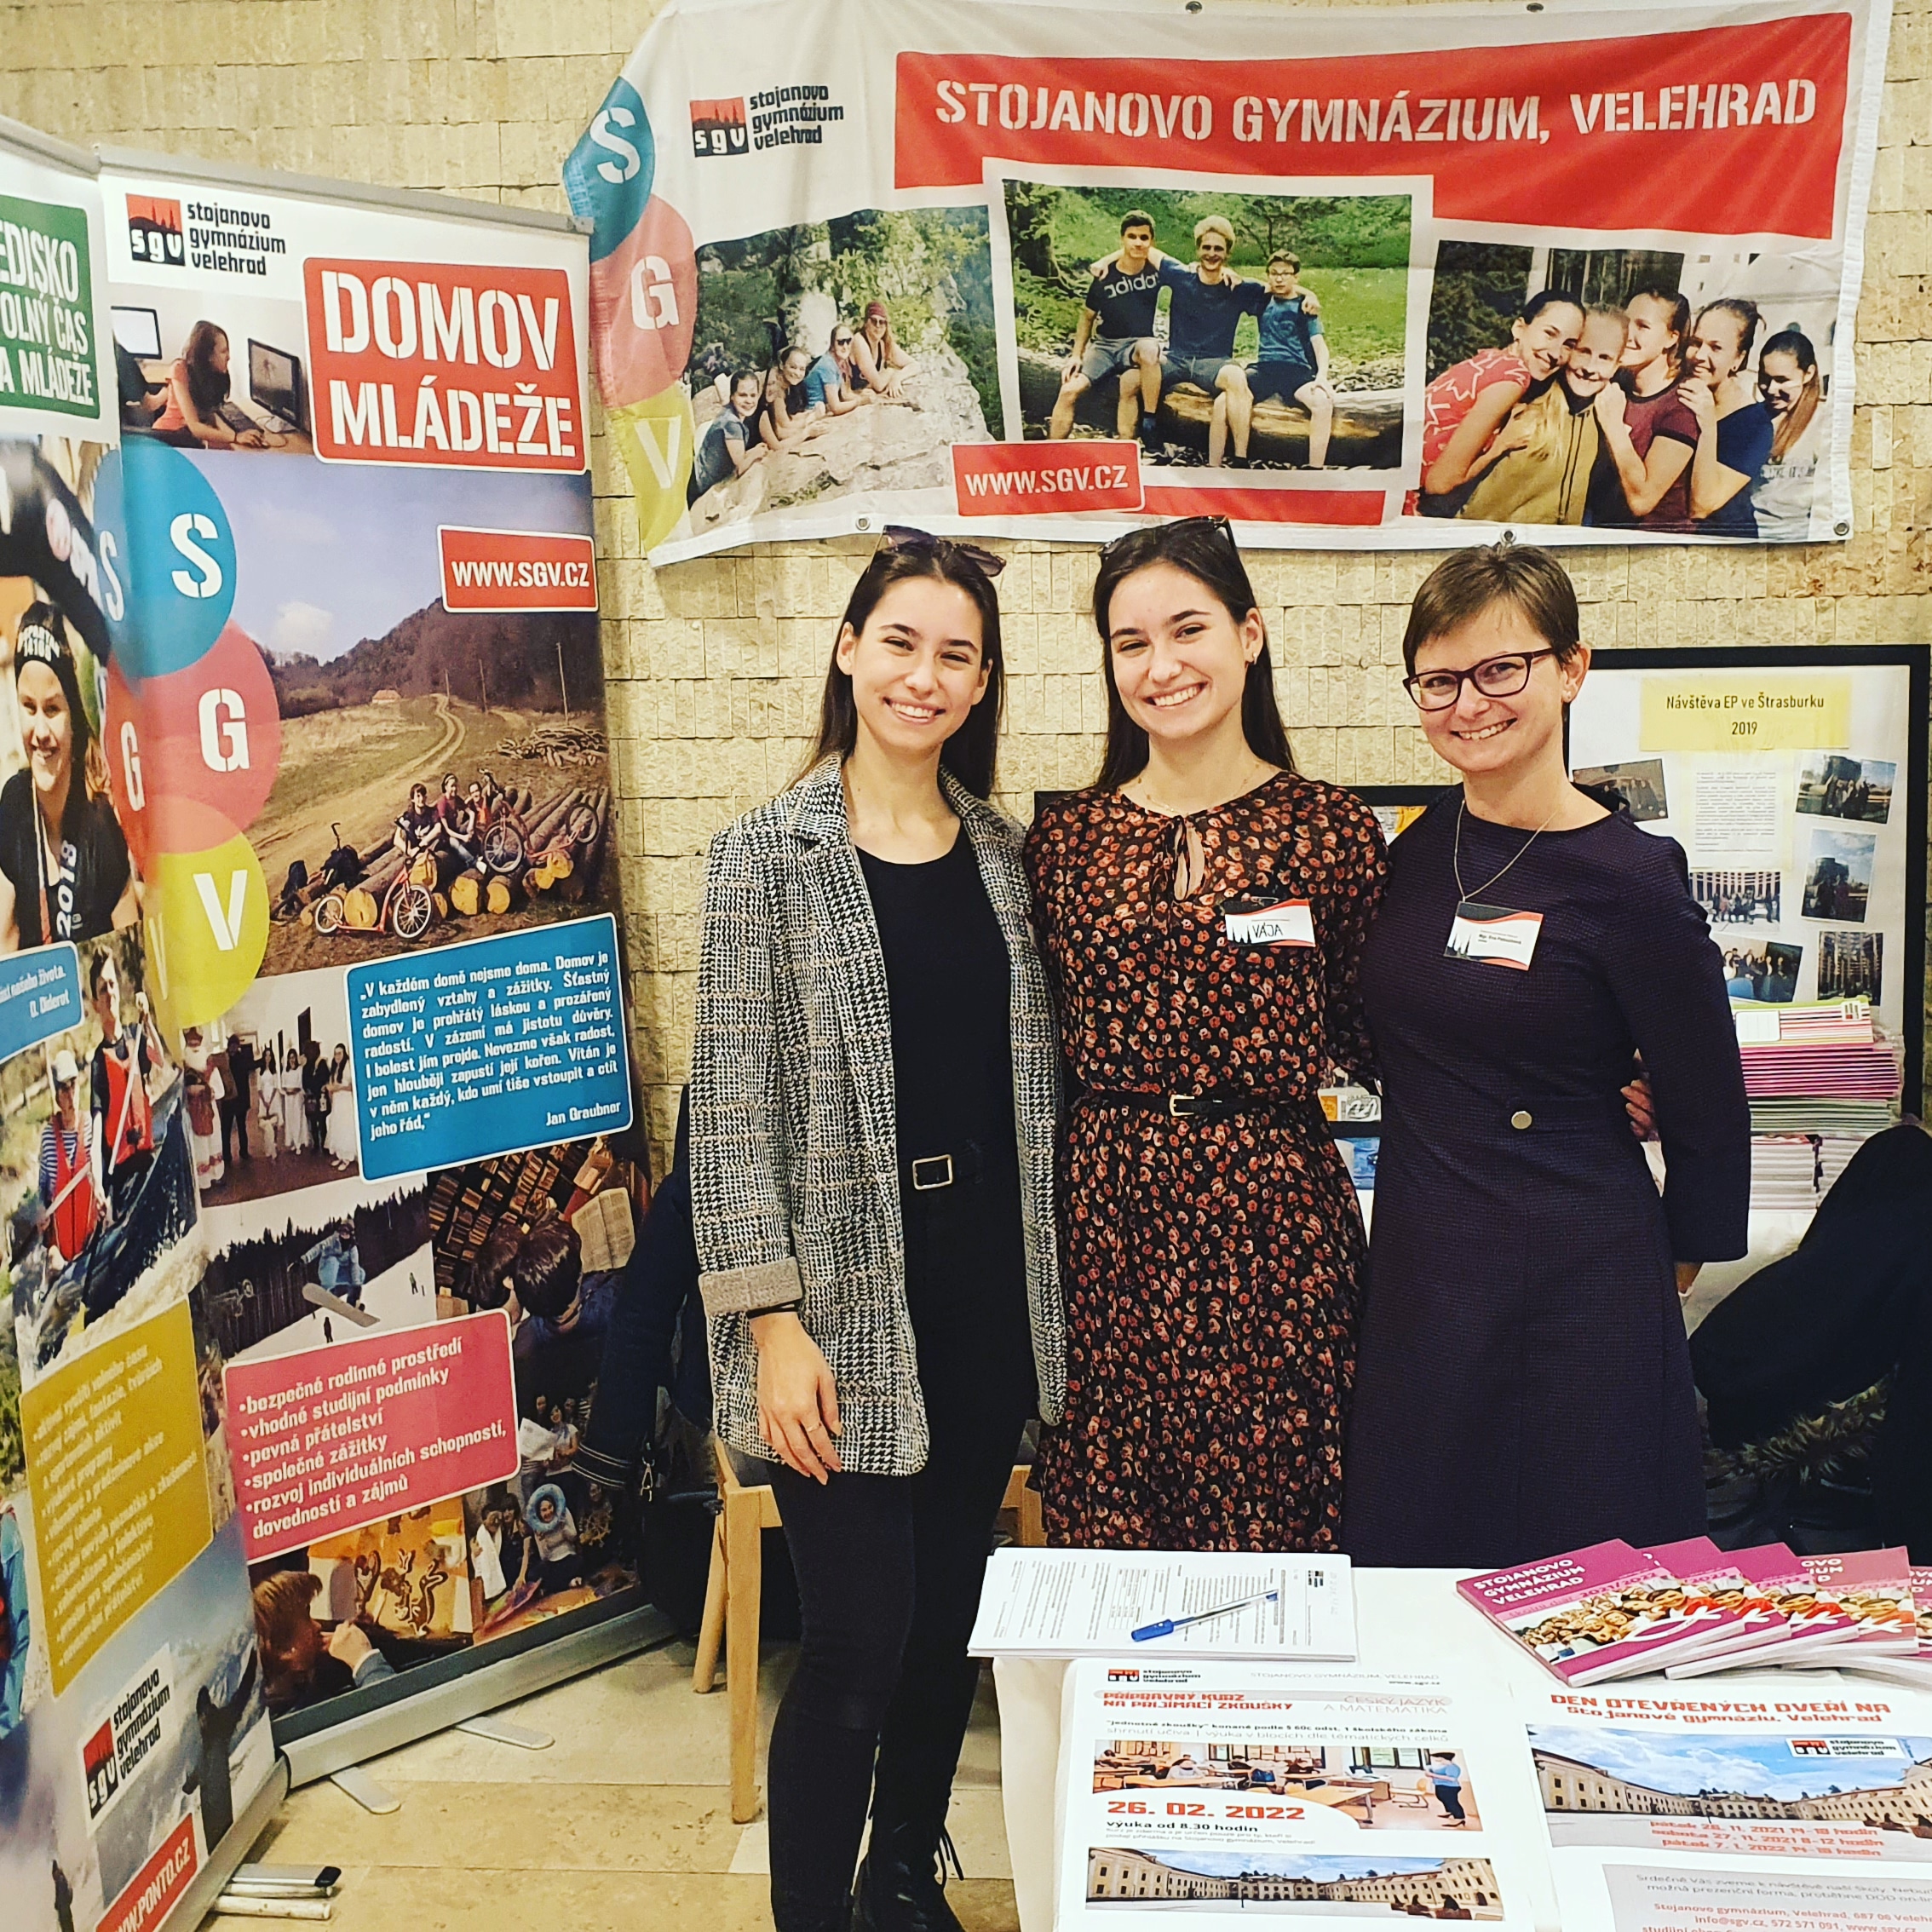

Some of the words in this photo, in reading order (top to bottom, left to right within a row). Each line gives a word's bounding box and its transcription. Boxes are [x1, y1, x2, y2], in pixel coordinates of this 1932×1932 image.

[750, 84, 830, 112] stojanovo
[752, 101, 844, 134] gymnázium
[936, 79, 1213, 141] STOJANOVO
[1232, 89, 1550, 145] GYMNÁZIUM,
[1569, 78, 1817, 135] VELEHRAD
[589, 106, 641, 184] S
[694, 127, 746, 155] sgv
[753, 124, 823, 151] velehrad
[187, 202, 270, 229] stojanovo
[132, 229, 183, 263] sgv
[189, 227, 286, 255] gymnázium
[192, 250, 267, 275] velehrad
[630, 255, 681, 331] G
[1104, 272, 1160, 299] adida
[54, 296, 89, 356] ČAS
[321, 270, 561, 371] DOMOV
[19, 347, 95, 406] MLÁDEŽE
[330, 374, 576, 457] MLÁDEŽE
[633, 421, 680, 489] V
[963, 463, 1130, 498] WWW.SGV.CZ
[170, 513, 223, 599] S
[451, 559, 590, 589] WWW.SGV.CZ
[1666, 694, 1721, 710] Návštěva
[1723, 695, 1738, 709] EP
[1740, 699, 1755, 709] ve
[1757, 692, 1825, 709] Štrasburku
[198, 687, 250, 773] G
[1732, 722, 1758, 736] 2019
[193, 870, 248, 952] V
[361, 998, 425, 1019] zabydlený
[436, 989, 477, 1007] vztahy
[487, 987, 495, 998] a
[506, 979, 552, 996] zážitky.
[562, 971, 609, 987] Šťastný
[378, 976, 429, 996] každém
[433, 969, 466, 987] domě
[469, 966, 511, 983] nejsme
[515, 960, 551, 975] doma.
[555, 954, 595, 970] Domov
[597, 951, 608, 967] je
[362, 1021, 404, 1038] domov
[411, 1016, 424, 1033] je
[432, 1007, 483, 1031] prohřátý
[490, 1001, 530, 1017] láskou
[538, 999, 546, 1010] a
[553, 989, 611, 1010] prozářený
[364, 1037, 414, 1059] radostí.
[424, 1032, 434, 1048] V
[445, 1024, 485, 1045] zázemí
[494, 1020, 513, 1036] má
[521, 1014, 562, 1035] jistotu
[572, 1006, 612, 1023] důvěry.
[365, 1063, 371, 1078] I
[374, 1057, 415, 1077] bolest
[417, 1054, 438, 1072] jím
[441, 1045, 480, 1068] projde.
[484, 1038, 537, 1057] Nevezme
[540, 1029, 571, 1047] však
[574, 1024, 615, 1042] radost,
[366, 1084, 387, 1101] jen
[394, 1071, 444, 1093] hlouběji
[451, 1061, 493, 1084] zapustí
[499, 1057, 518, 1077] její
[524, 1053, 561, 1069] kořen.
[567, 1044, 600, 1061] Vítán
[605, 1042, 616, 1058] je
[369, 1107, 377, 1118] v
[381, 1099, 409, 1116] něm
[411, 1090, 454, 1110] každý,
[457, 1084, 478, 1101] kdo
[480, 1078, 503, 1096] umí
[505, 1076, 529, 1091] tiše
[532, 1066, 583, 1086] vstoupit
[586, 1066, 594, 1077] a
[597, 1060, 618, 1075] ctít
[545, 1112, 566, 1125] Jan
[568, 1101, 620, 1121] Graubner
[370, 1120, 397, 1141] jeho
[246, 1377, 323, 1415] bezpečné
[327, 1360, 386, 1390] rodinné
[391, 1337, 462, 1375] prostředí
[248, 1406, 308, 1439] vhodné
[312, 1386, 371, 1420] studijní
[375, 1367, 449, 1405] podmínky
[250, 1433, 300, 1467] pevná
[304, 1408, 382, 1451] přátelství
[251, 1451, 325, 1488] společné
[329, 1434, 387, 1464] zážitky
[253, 1482, 303, 1514] rozvoj
[308, 1448, 415, 1496] individuálních
[419, 1419, 506, 1460] schopností,
[252, 1495, 341, 1539] dovedností
[345, 1493, 356, 1508] a
[361, 1475, 408, 1504] zájmů
[1473, 1559, 1573, 1590] STOJANOVO
[1483, 1565, 1586, 1597] GYMNÁZIUM
[1492, 1577, 1584, 1605] VELEHRAD
[113, 1668, 160, 1731] stojanovo
[117, 1684, 170, 1760] gymnázium
[1340, 1705, 1448, 1715] MATEMATIKA
[1550, 1694, 1597, 1706] DEN
[1605, 1699, 1767, 1712] OTEVŘENÝCH
[1774, 1699, 1848, 1712] DVEŘÍ
[1854, 1703, 1891, 1713] NA
[1787, 1714, 1883, 1722] Velehrad
[120, 1716, 161, 1780] velehrad
[89, 1757, 117, 1809] sgv
[1107, 1801, 1155, 1814] 26.
[1167, 1803, 1215, 1817] 02.
[1225, 1805, 1305, 1820] 2022
[1107, 1820, 1152, 1829] výuka
[1181, 1822, 1210, 1831] 8.30
[1215, 1824, 1258, 1832] hodin
